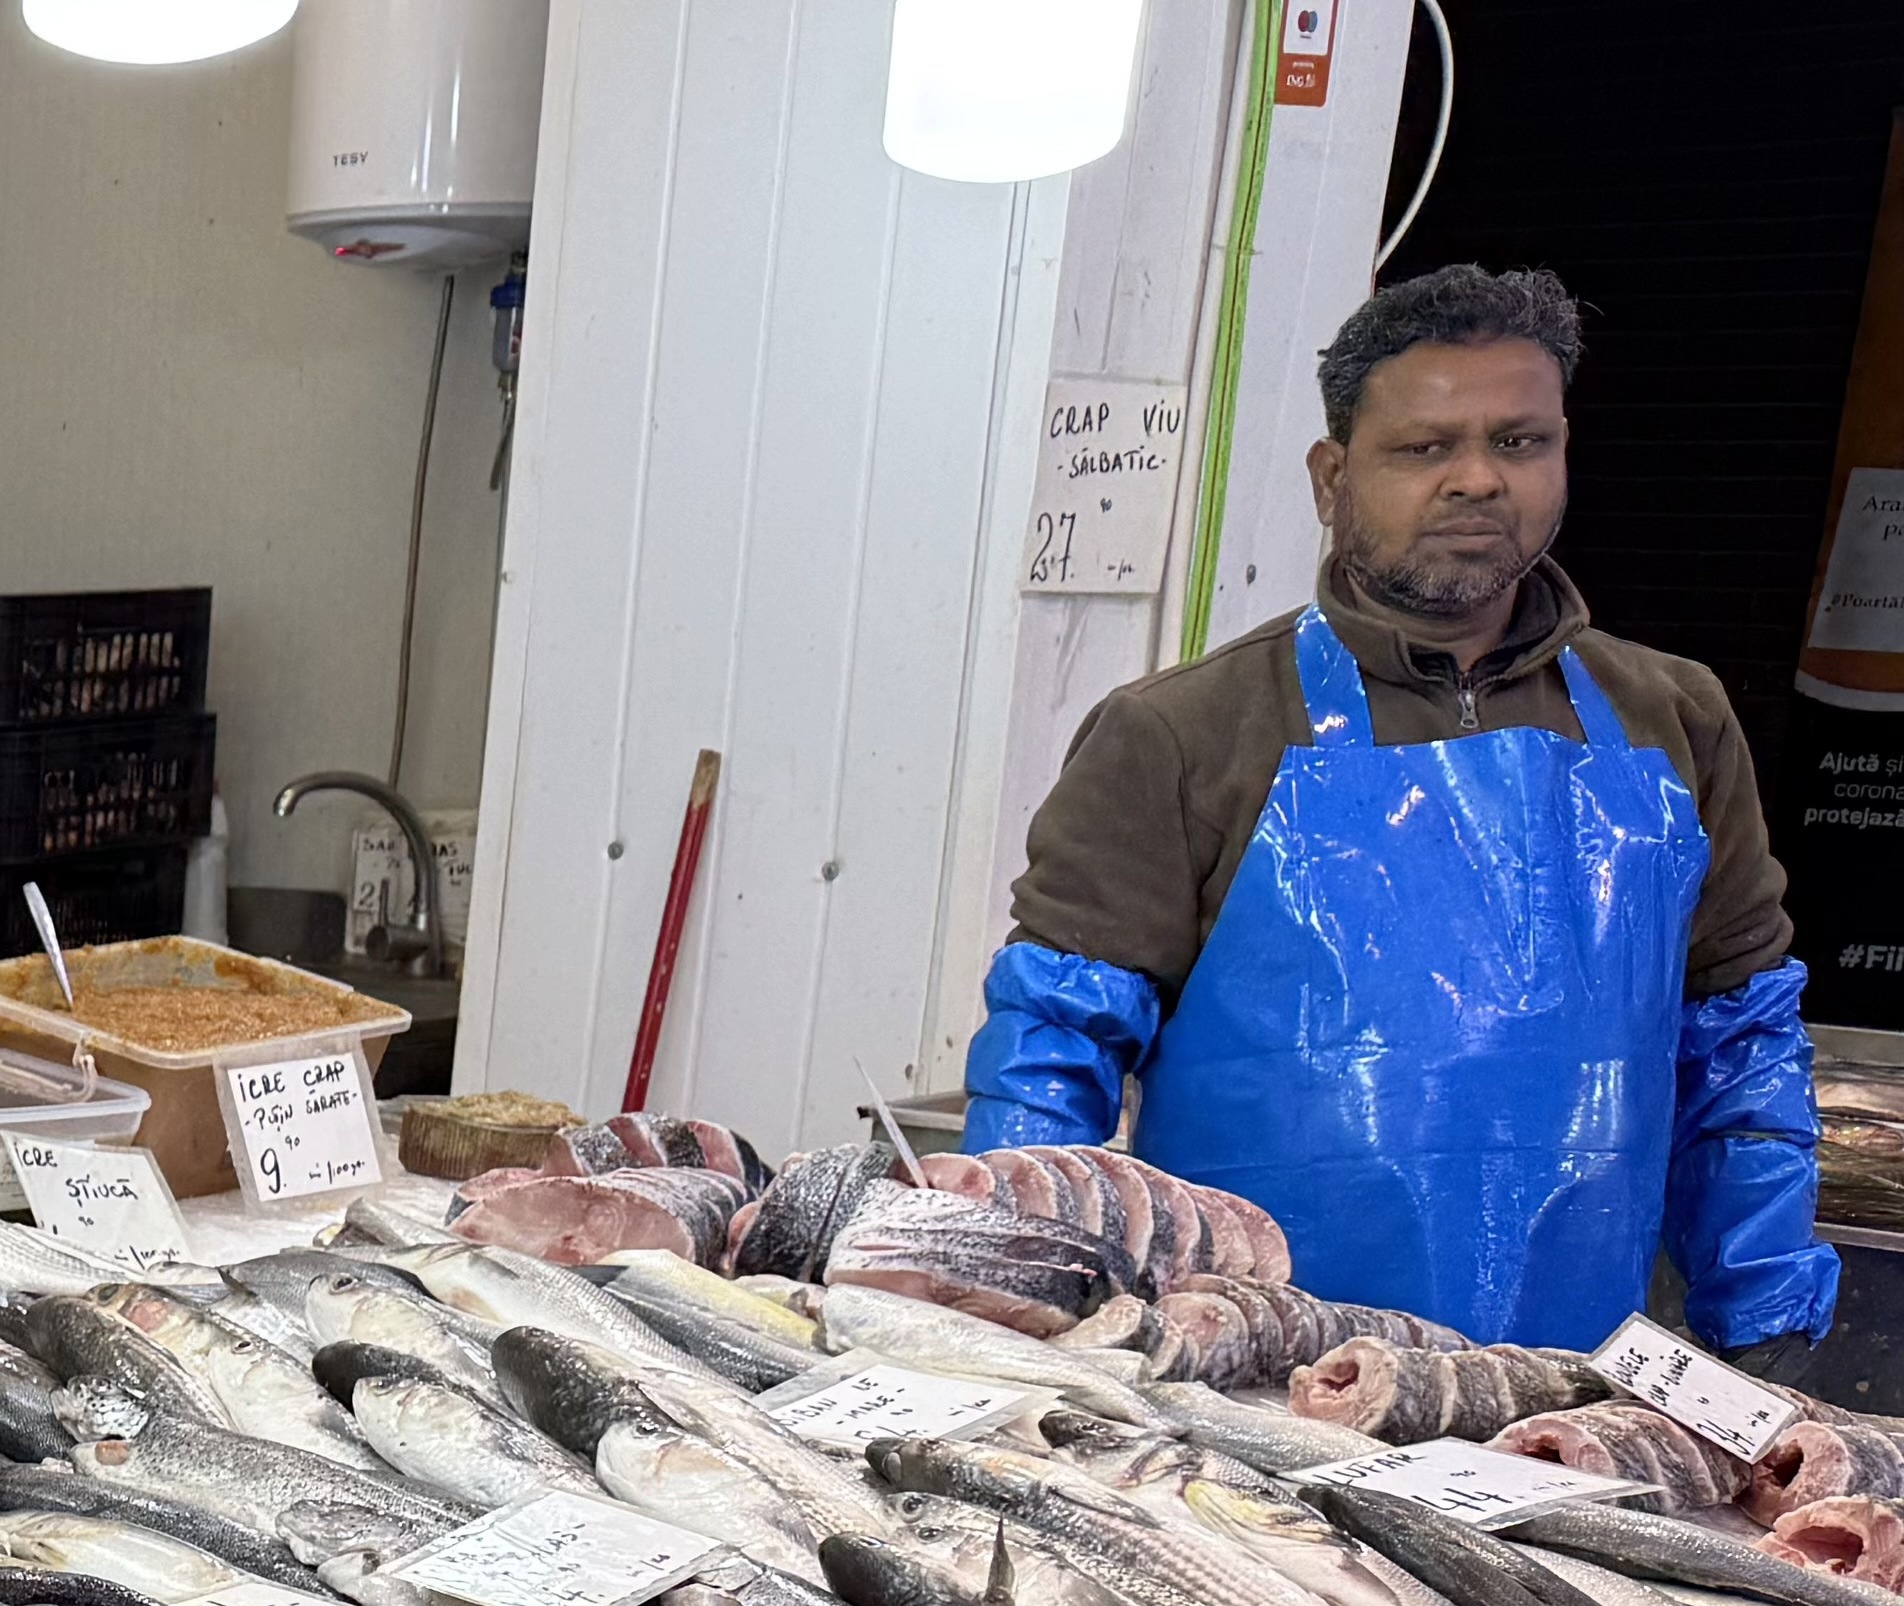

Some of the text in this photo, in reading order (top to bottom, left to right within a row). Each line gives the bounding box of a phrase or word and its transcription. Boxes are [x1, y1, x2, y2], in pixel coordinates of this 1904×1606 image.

[1050, 402, 1110, 438] CRAP
[1862, 495, 1904, 513] Ara
[1819, 752, 1880, 774] Ajută
[303, 1061, 345, 1087] CRAP
[284, 1134, 301, 1150] 90
[1312, 1452, 1428, 1486] LUFAR
